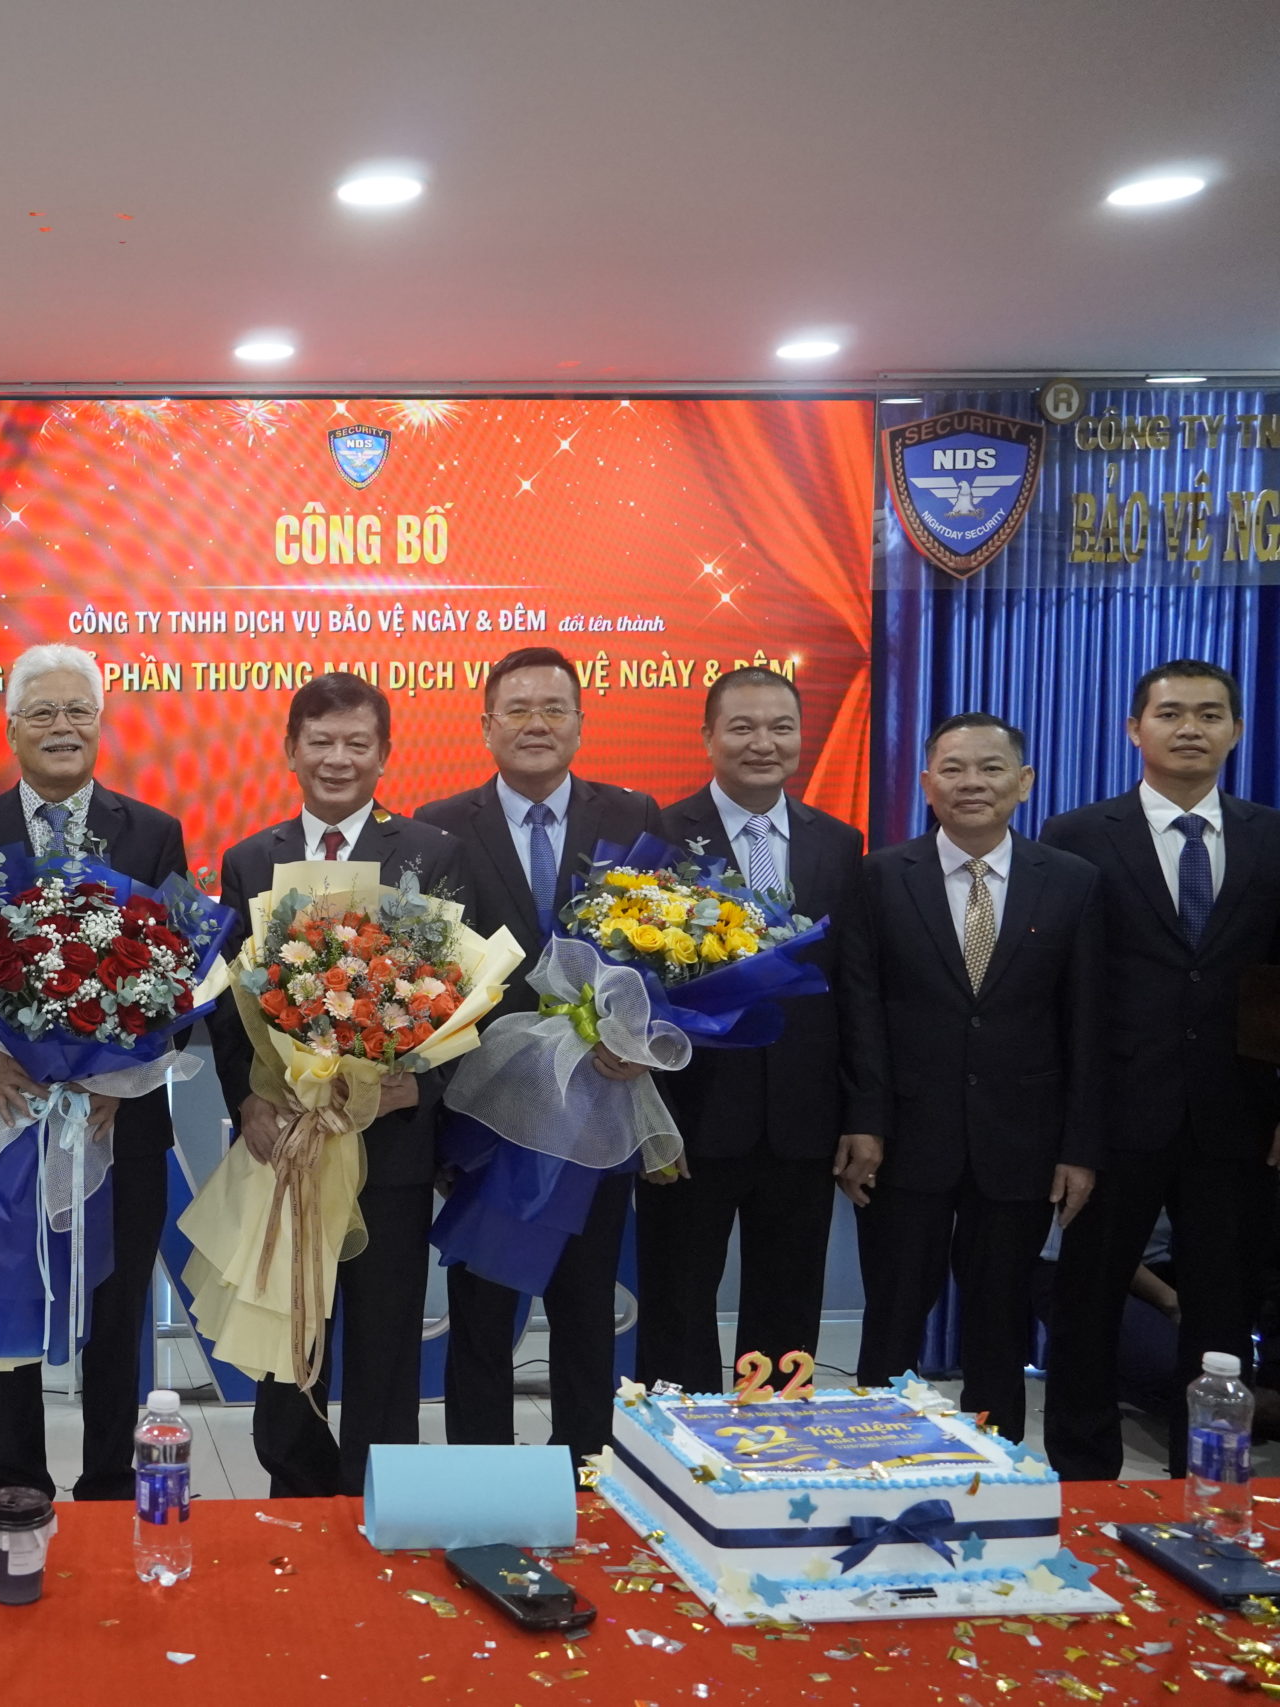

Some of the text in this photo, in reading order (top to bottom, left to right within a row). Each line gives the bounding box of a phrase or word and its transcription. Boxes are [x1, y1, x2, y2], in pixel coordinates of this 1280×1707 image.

[336, 426, 383, 437] SECURITY
[346, 439, 373, 448] NDS
[905, 414, 1020, 445] SECURITY
[1075, 406, 1170, 450] CÔNG
[1180, 414, 1226, 449] TY
[933, 448, 996, 470] NDS
[275, 502, 454, 565] CÔNG BỐ
[921, 507, 1006, 540] NIGHTDAY SECURITY
[1069, 463, 1280, 579] BẢO VỆ NG
[69, 602, 666, 638] CÔNG TY TNHH DỊCH VỤ BẢO VỆ NGÀY & ĐÊM đổi tên thành
[104, 652, 182, 692] PHẦN
[191, 661, 314, 691] THƯƠNG
[389, 661, 455, 697] DỊCH
[575, 650, 610, 696] VỆ
[620, 651, 695, 688] NGÀY
[702, 659, 723, 688] &
[736, 1350, 815, 1400] 22
[848, 1421, 912, 1434] niệm
